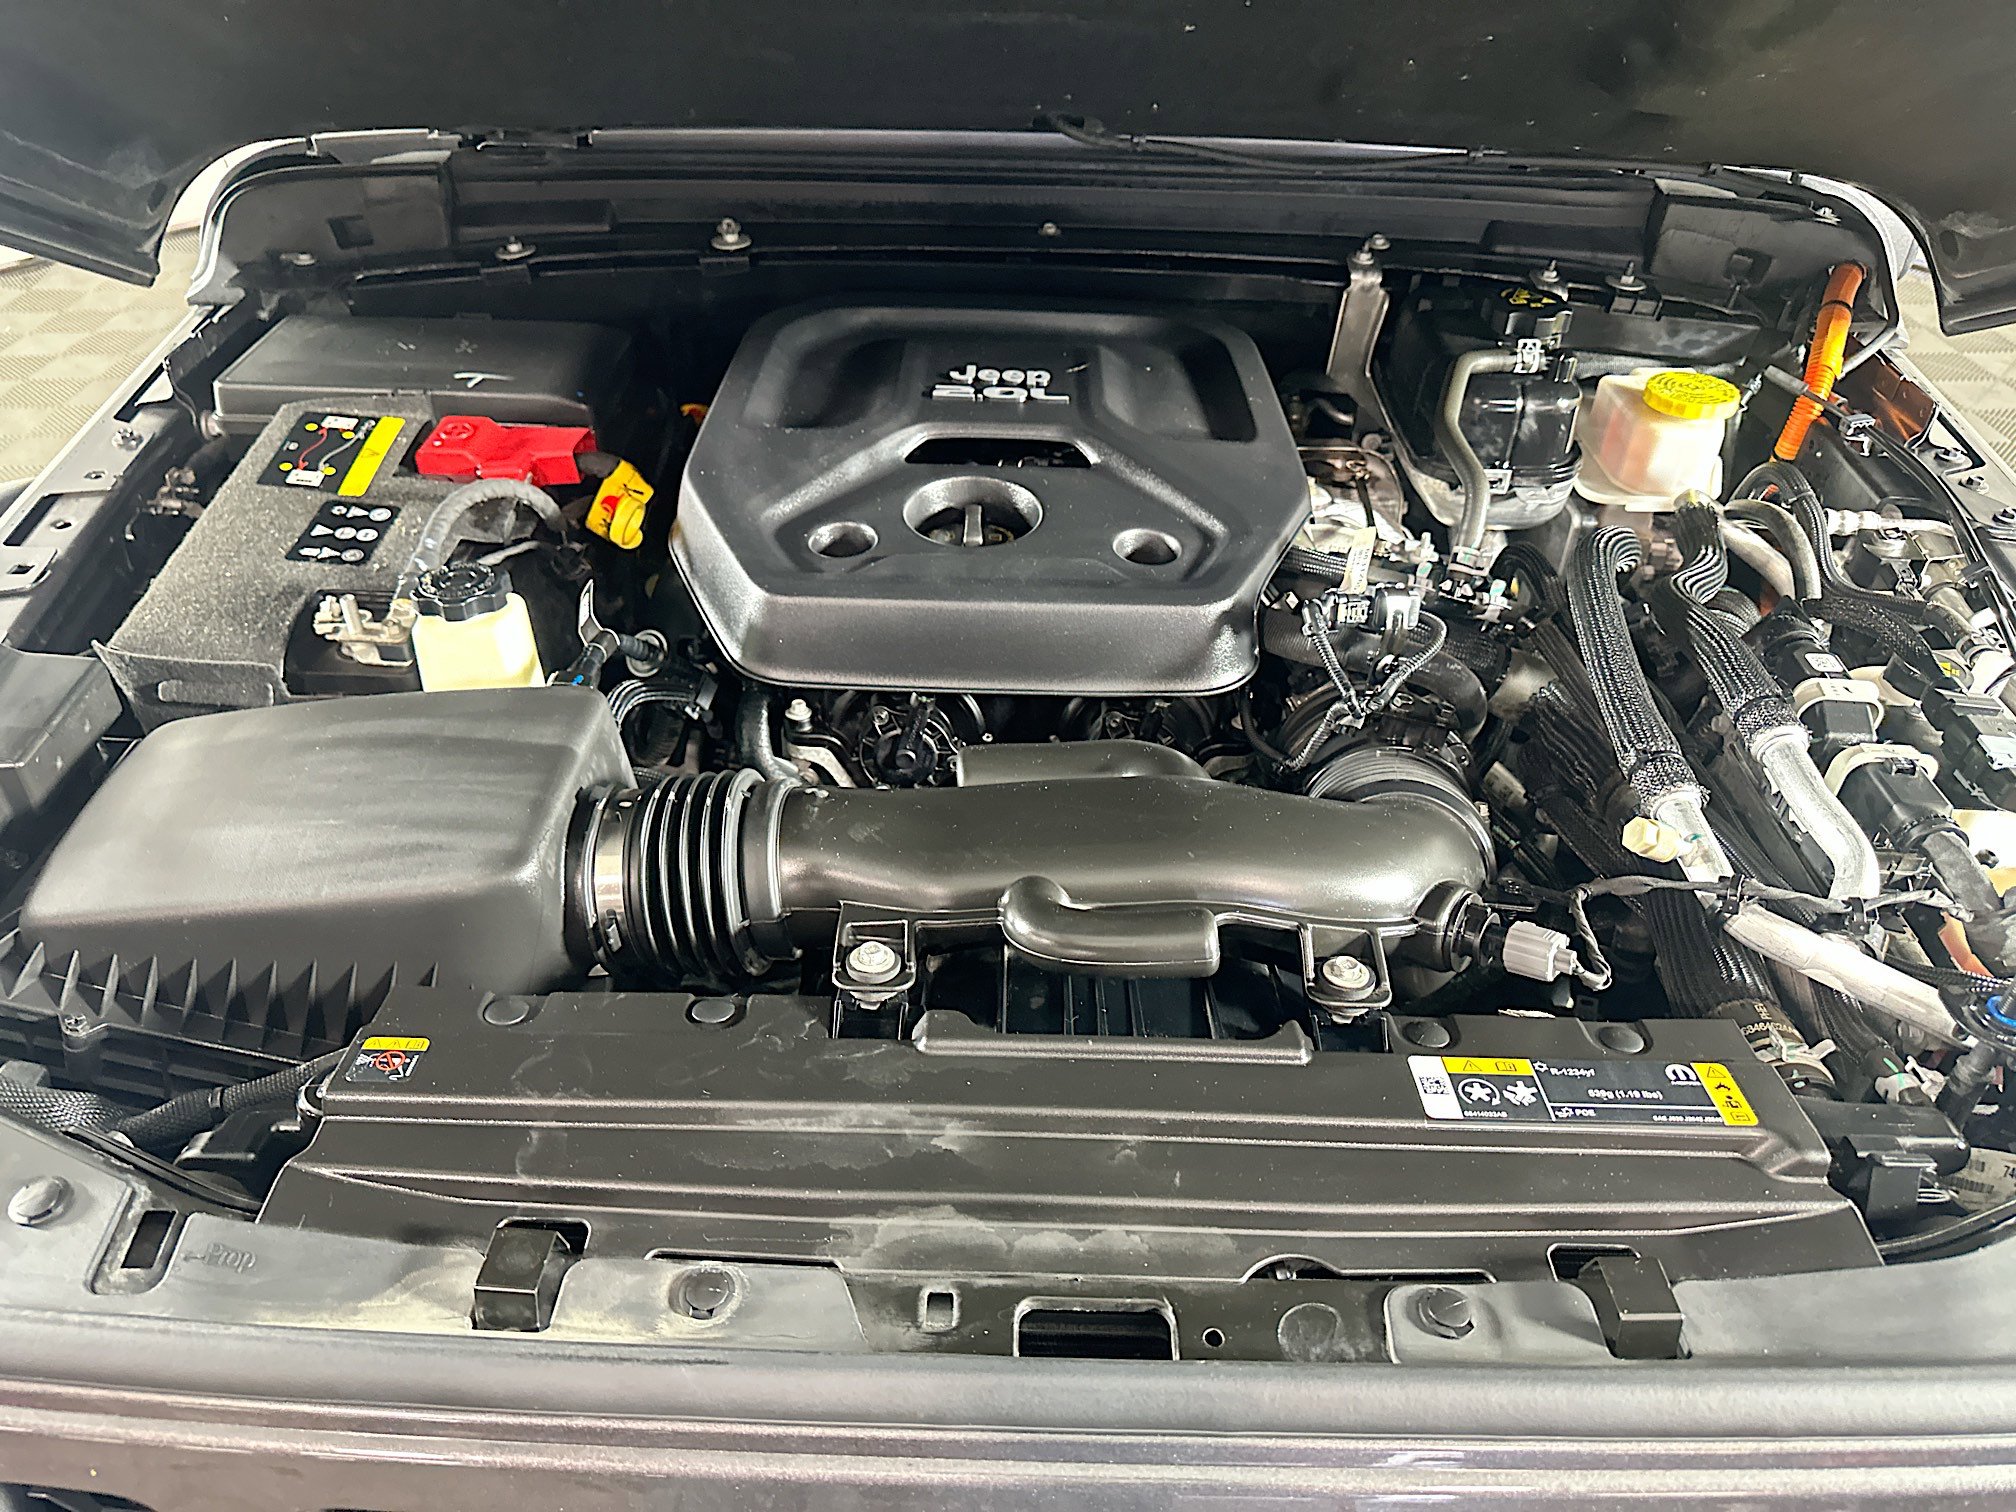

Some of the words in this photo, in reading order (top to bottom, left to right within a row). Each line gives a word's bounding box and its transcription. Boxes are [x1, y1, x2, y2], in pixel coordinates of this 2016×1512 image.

[949, 364, 1052, 387] Jeep
[932, 384, 1070, 404] 2.0L
[203, 1242, 257, 1273] Prop
